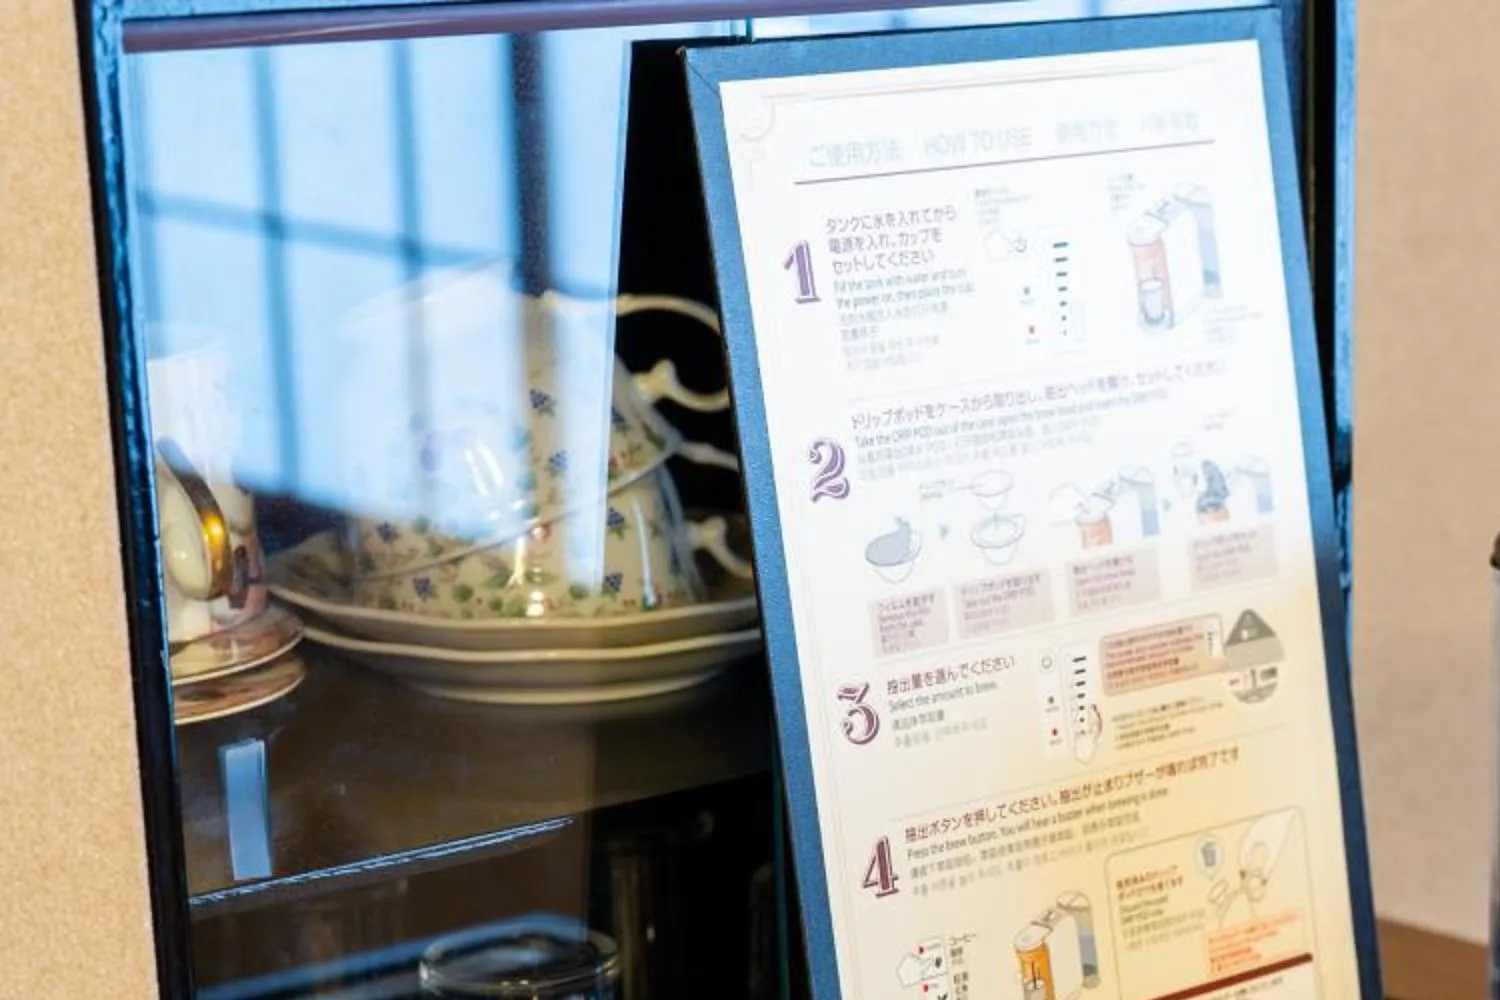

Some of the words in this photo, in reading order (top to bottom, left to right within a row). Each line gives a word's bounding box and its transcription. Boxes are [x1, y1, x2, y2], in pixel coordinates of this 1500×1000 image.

[923, 130, 966, 157] HOW
[969, 128, 994, 153] TO
[997, 126, 1033, 150] USE
[783, 238, 822, 305] 1
[809, 437, 850, 503] 2
[837, 681, 880, 745] 3
[862, 835, 900, 898] 4
